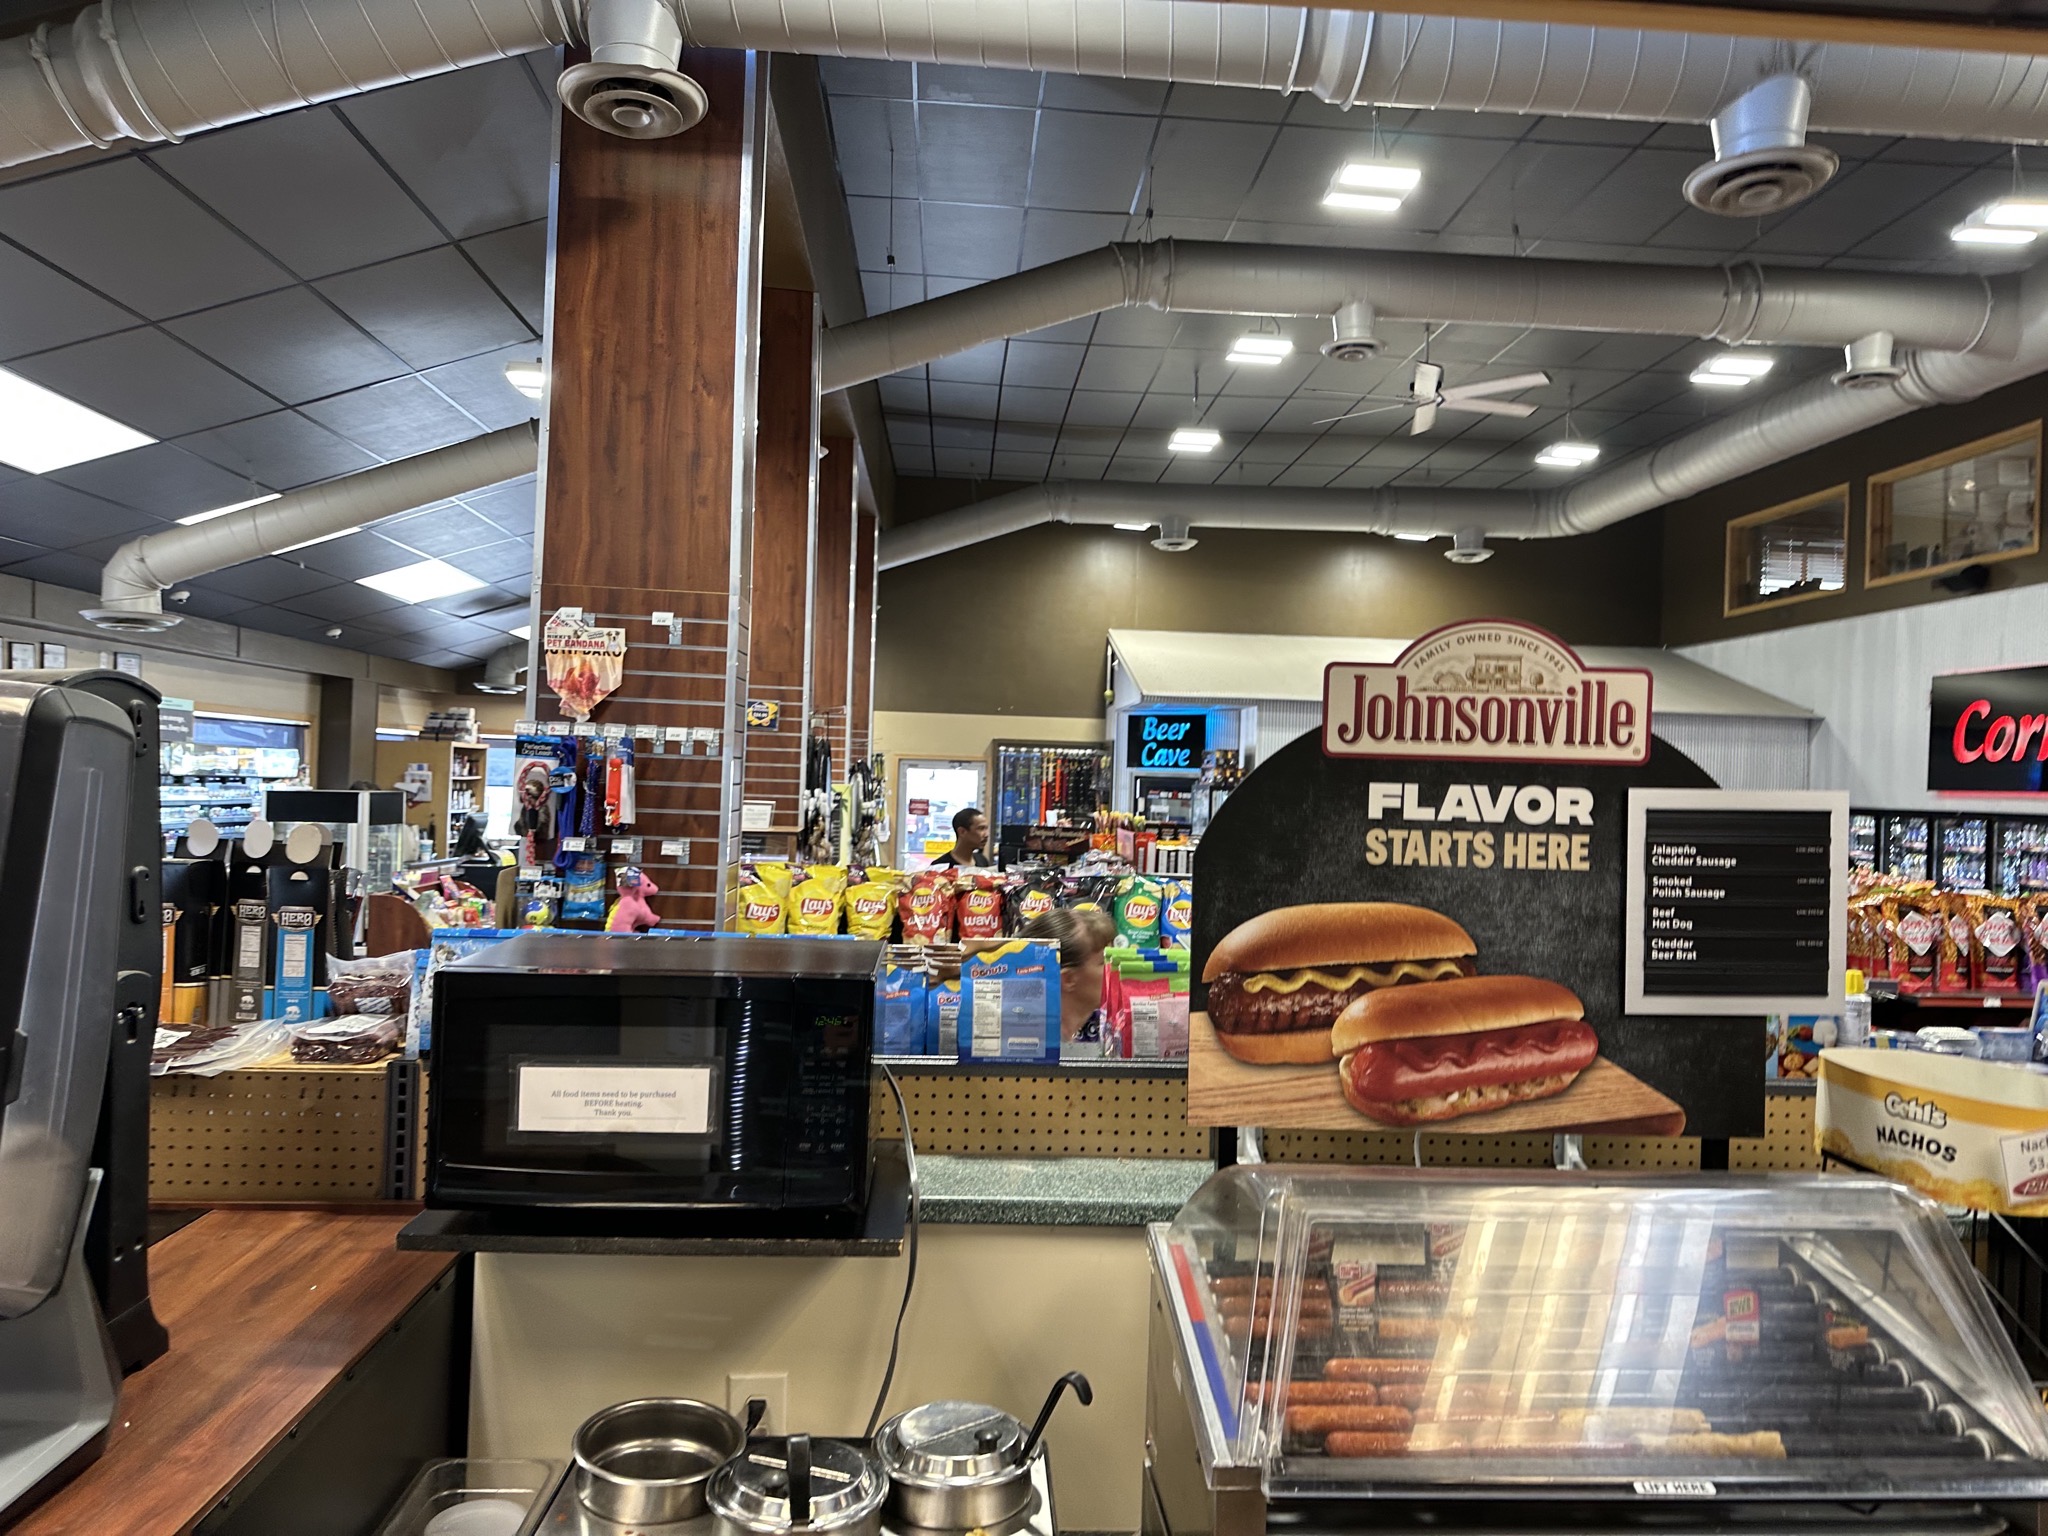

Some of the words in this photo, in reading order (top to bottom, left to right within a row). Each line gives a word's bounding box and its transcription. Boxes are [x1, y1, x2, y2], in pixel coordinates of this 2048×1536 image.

[547, 639, 563, 648] PET
[565, 640, 606, 649] BANDANA
[1414, 640, 1452, 670] FAMILY
[1456, 632, 1502, 647] OWNED
[1507, 634, 1541, 653] SINCE
[1543, 649, 1566, 674] 1945
[1337, 674, 1636, 750] Johnsonville
[1142, 716, 1191, 741] Beer
[1141, 741, 1191, 767] Cave
[1368, 782, 1594, 826] FLAVOR
[1365, 827, 1496, 869] STARTS
[1503, 831, 1591, 871] HERE
[1652, 844, 1697, 857] Jalapeño
[1652, 855, 1694, 867] Cheddar
[1696, 856, 1737, 869] Sausage
[1652, 876, 1693, 887] Smoked
[912, 893, 935, 908] Lay's
[1652, 887, 1683, 898] Polish
[1685, 888, 1726, 900] Sausage
[803, 898, 833, 916] Lay's
[857, 899, 887, 915] Lay's
[968, 894, 993, 909] Lay's
[1021, 897, 1050, 913] Lay's
[238, 904, 266, 919] HERO
[748, 903, 780, 922] Lay's
[1127, 902, 1156, 920] Lay's
[1652, 907, 1675, 918] Beef
[281, 912, 312, 926] HERO
[907, 915, 941, 930] wavy
[964, 915, 998, 929] wavy
[1652, 919, 1670, 930] Hot
[1673, 919, 1693, 931] Dog
[1652, 938, 1694, 950] Cheddar
[1652, 950, 1674, 961] Beer
[1677, 950, 1697, 961] Brat
[971, 963, 1008, 978] Donuts
[551, 1090, 561, 1098] All
[562, 1090, 579, 1098] food
[580, 1090, 601, 1098] items
[602, 1090, 619, 1098] need
[629, 1090, 639, 1098] be
[640, 1090, 677, 1099] purchased
[617, 1110, 632, 1118] you.
[1885, 1091, 1948, 1129] Gehl's
[1876, 1125, 1958, 1163] NACHOS
[1642, 1481, 1668, 1494] LIFT
[1672, 1481, 1708, 1495] HERE
